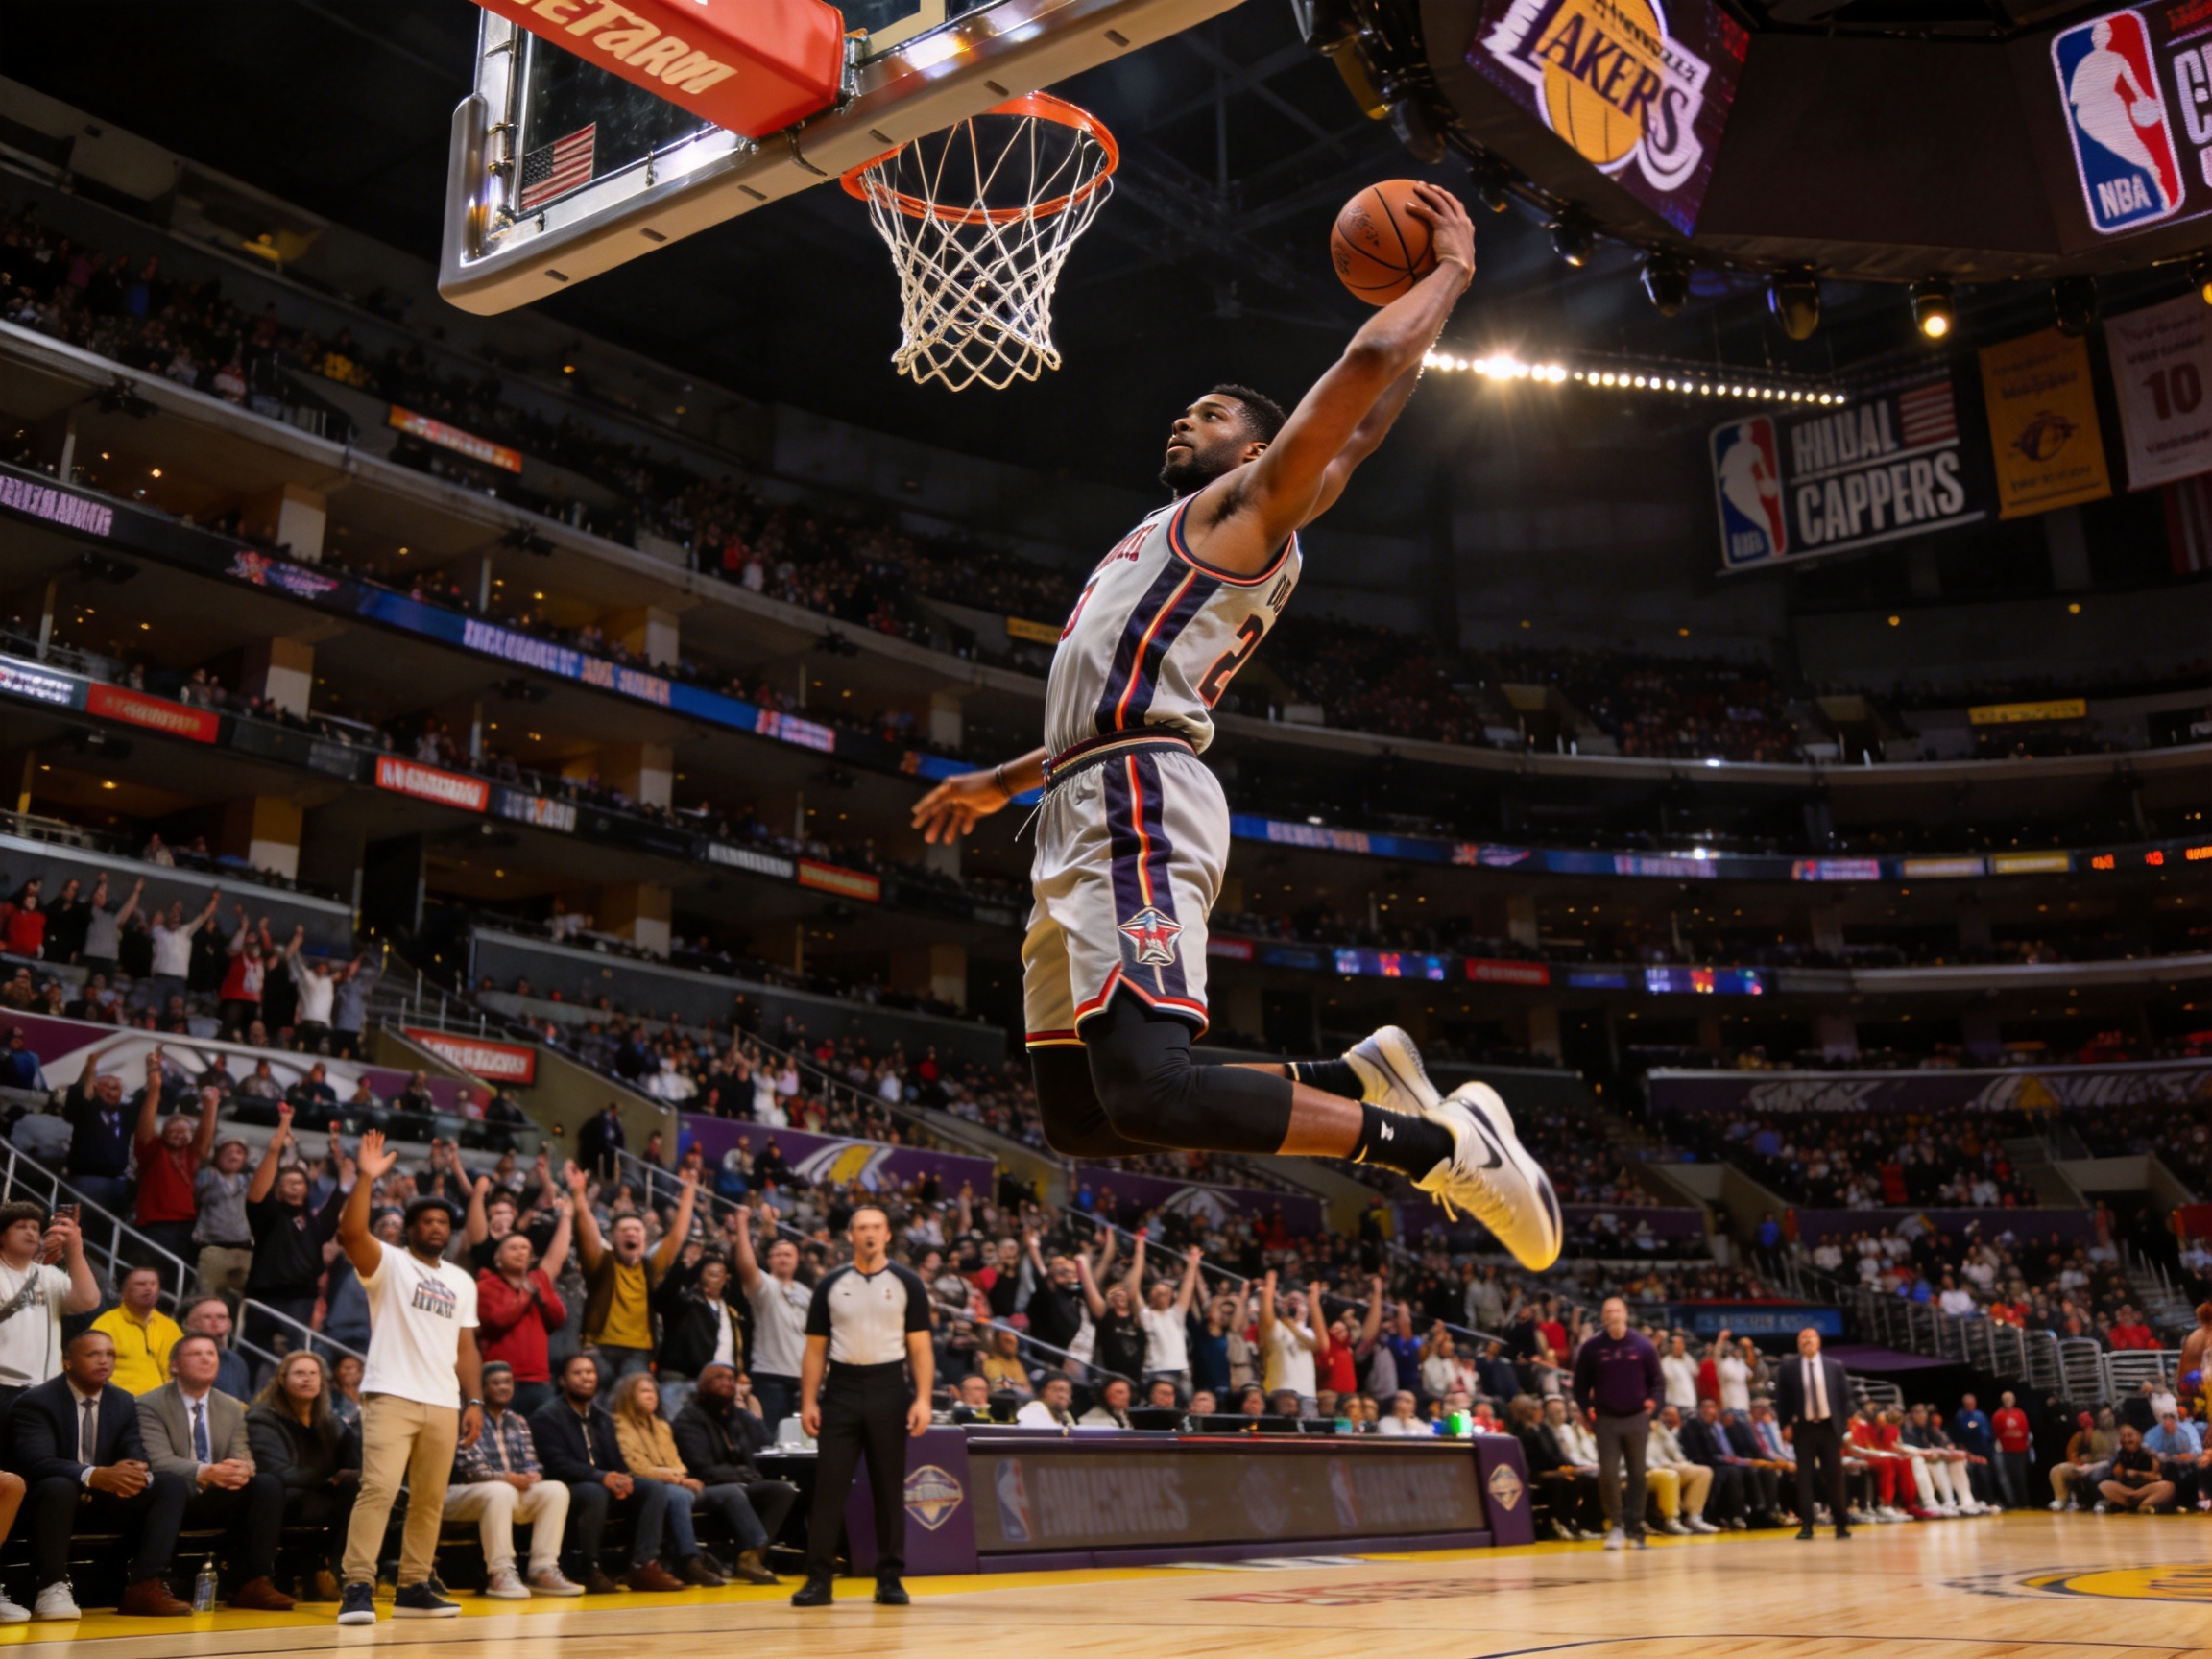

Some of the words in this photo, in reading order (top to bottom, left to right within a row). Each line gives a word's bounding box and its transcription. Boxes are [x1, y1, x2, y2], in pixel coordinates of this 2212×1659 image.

[2097, 174, 2152, 220] NBA
[2142, 362, 2202, 420] 10
[1797, 450, 1966, 545] CAPPERS
